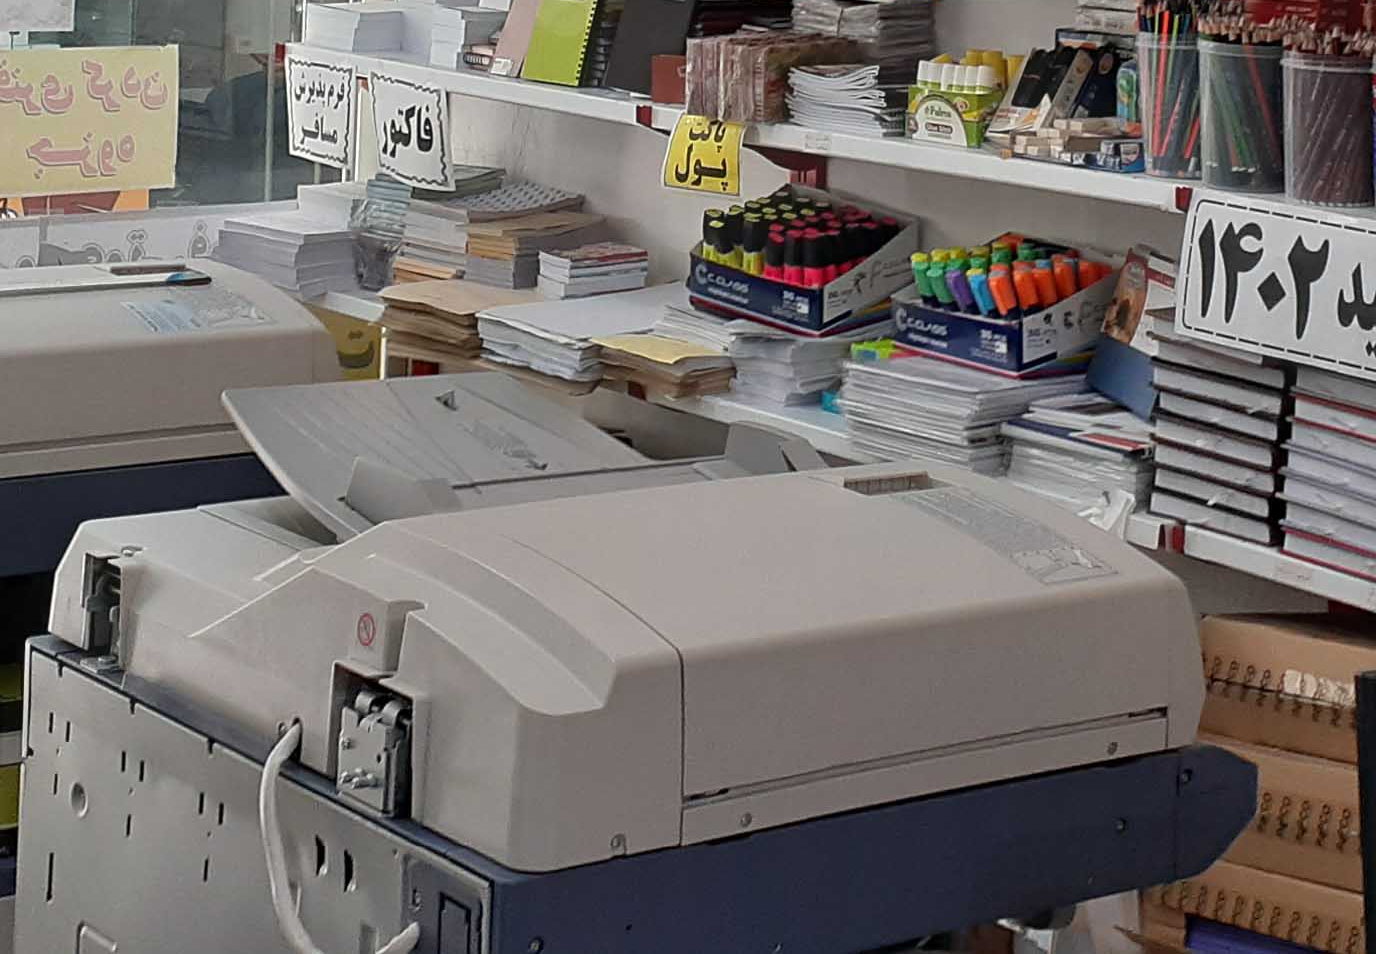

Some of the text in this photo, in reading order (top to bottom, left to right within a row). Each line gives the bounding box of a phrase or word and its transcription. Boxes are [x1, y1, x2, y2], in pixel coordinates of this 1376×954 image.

[294, 71, 345, 109] فرم پذیرش
[299, 112, 338, 144] مسافر
[381, 104, 434, 158] فاکتور
[689, 119, 726, 153] پاکت
[675, 142, 728, 192] پول
[1198, 218, 1330, 341] ۱۴۰۲
